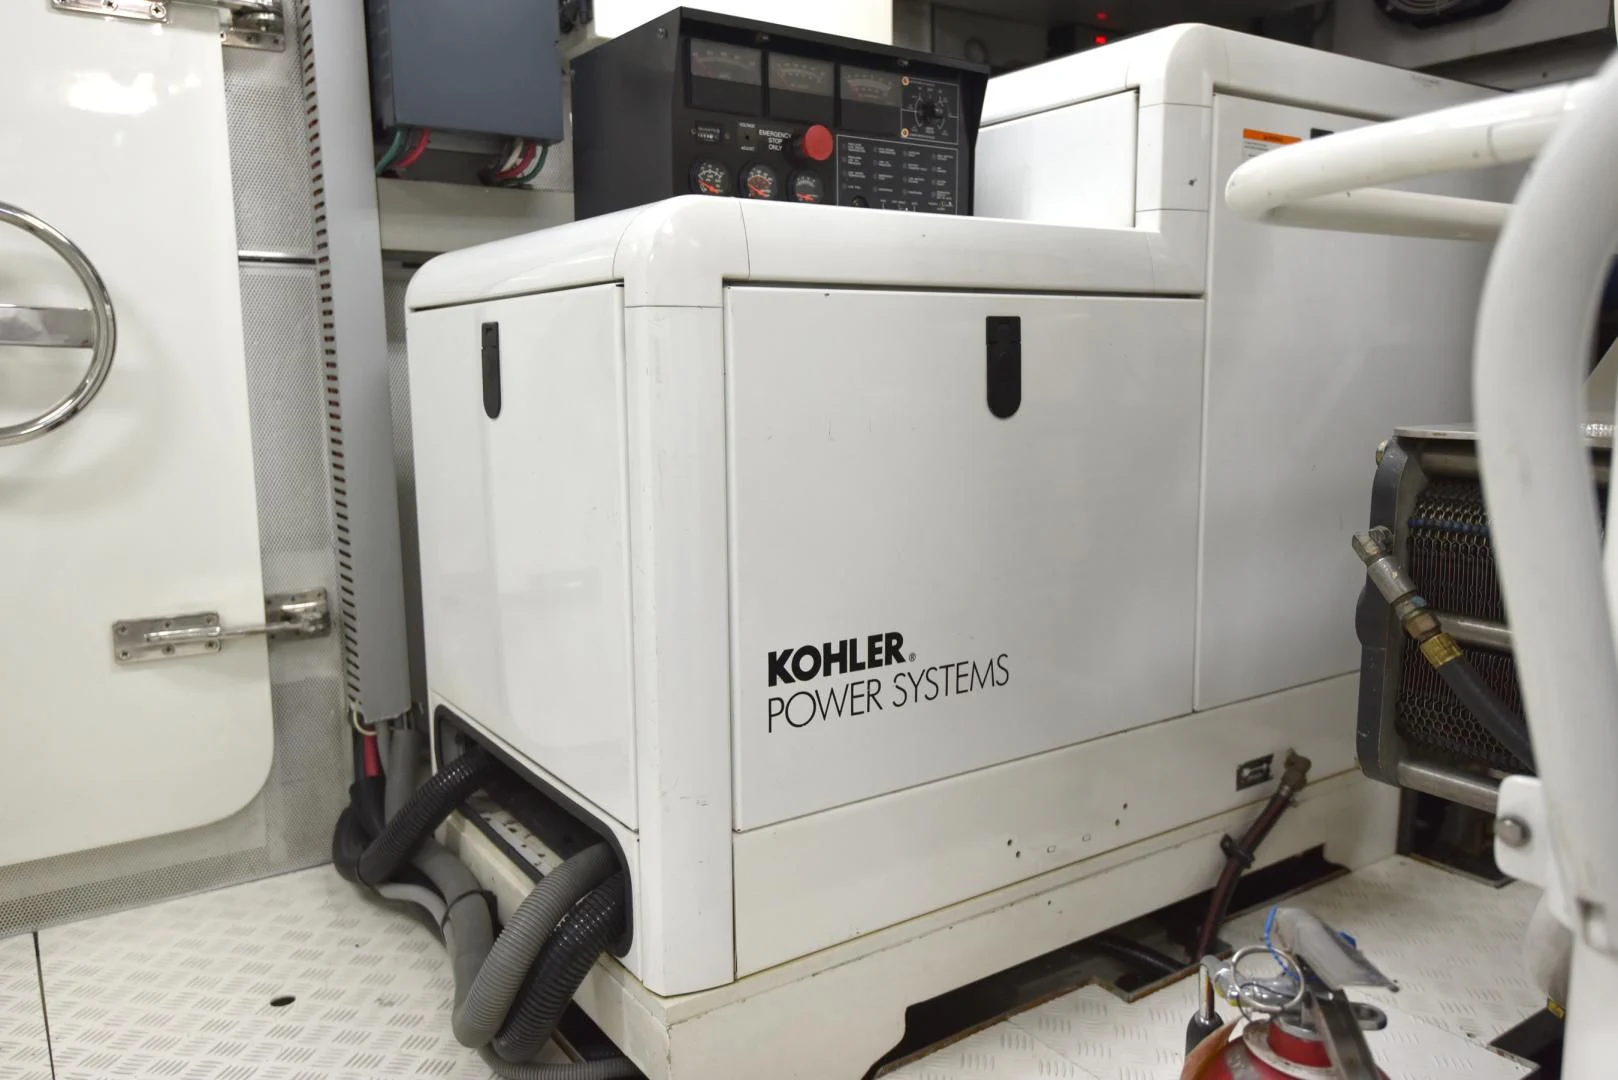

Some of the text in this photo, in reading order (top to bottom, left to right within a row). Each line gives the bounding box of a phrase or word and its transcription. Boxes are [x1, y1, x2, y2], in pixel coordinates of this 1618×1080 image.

[758, 129, 791, 139] EMERGENCY
[768, 631, 906, 687] KOHLER
[768, 653, 1010, 733] POWER SYSTEMS
